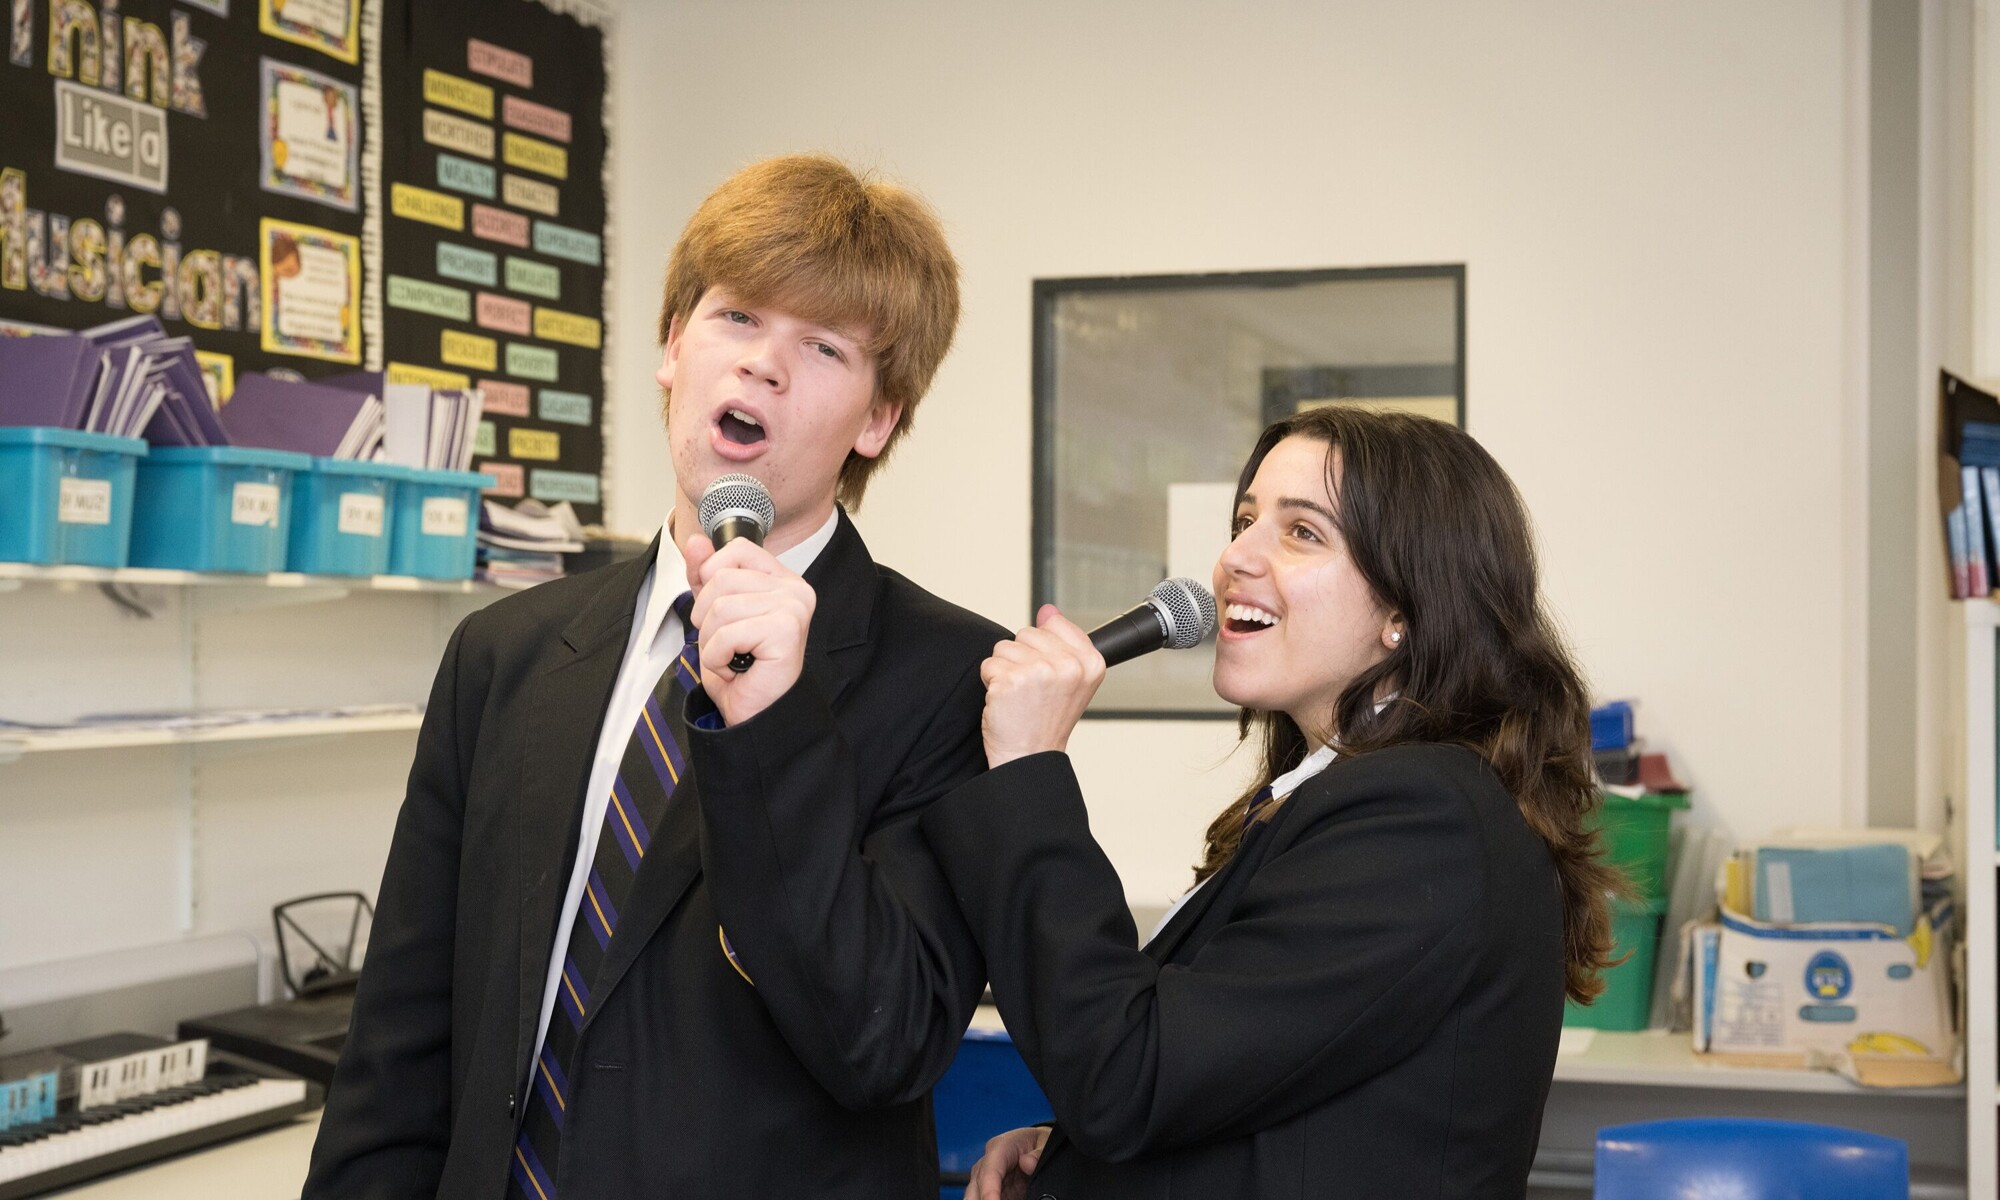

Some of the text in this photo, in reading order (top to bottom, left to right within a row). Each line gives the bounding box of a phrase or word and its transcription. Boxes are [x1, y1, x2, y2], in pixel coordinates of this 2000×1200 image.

[63, 96, 160, 168] Like a
[395, 191, 458, 222] CHALLENGE
[1154, 611, 1168, 637] SHURE
